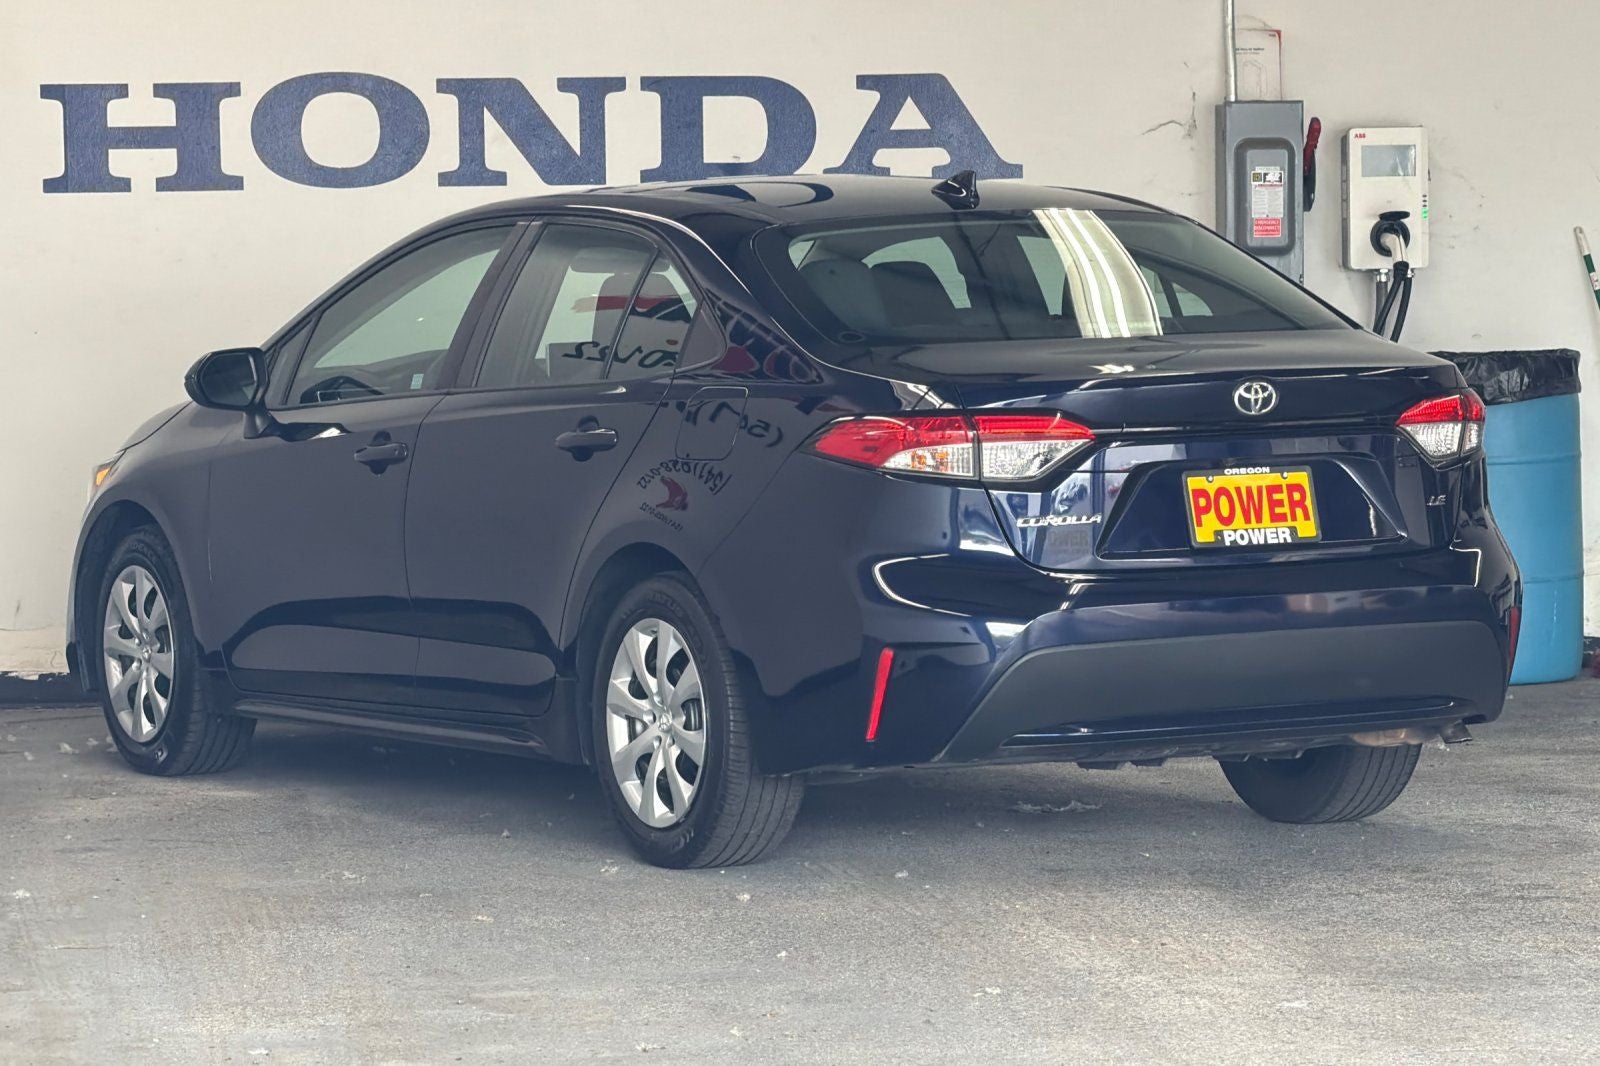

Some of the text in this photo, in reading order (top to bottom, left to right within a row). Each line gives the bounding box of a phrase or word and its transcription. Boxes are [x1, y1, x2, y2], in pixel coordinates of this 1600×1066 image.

[41, 71, 1023, 193] HONDA
[1224, 466, 1270, 475] OREGON
[1191, 483, 1310, 528] POWER
[1016, 513, 1102, 528] COROLLA
[1223, 527, 1292, 546] POWER
